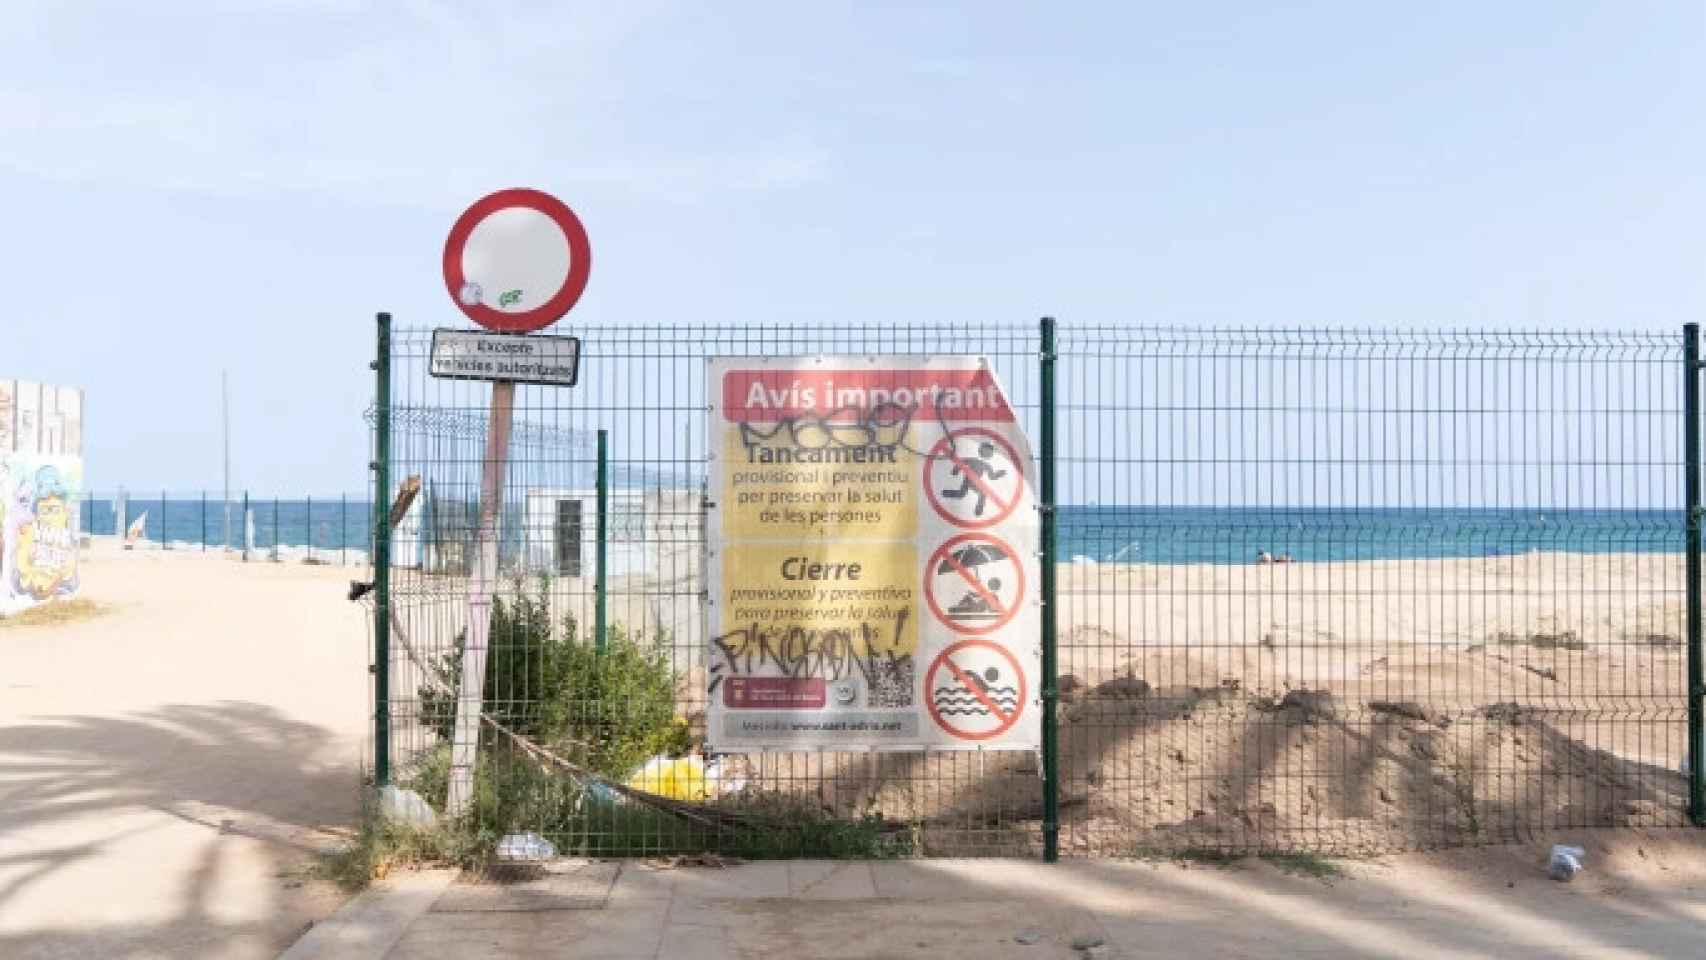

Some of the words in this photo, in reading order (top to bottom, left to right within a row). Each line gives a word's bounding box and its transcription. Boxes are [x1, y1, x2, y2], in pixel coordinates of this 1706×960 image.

[745, 375, 817, 409] Avís
[824, 379, 1002, 417] important
[747, 443, 897, 464] Tancament
[731, 470, 818, 488] provisional
[832, 470, 909, 488] preventiu
[737, 492, 766, 508] per
[771, 492, 843, 508] preservar
[847, 489, 861, 504] la
[864, 489, 903, 504] salut
[759, 509, 781, 524] de
[785, 509, 806, 524] les
[810, 510, 882, 527] persones
[781, 556, 862, 581] Cierre
[730, 586, 815, 604] provisional
[817, 590, 828, 604] y
[735, 608, 770, 621] para
[773, 607, 845, 622] preservar
[850, 605, 864, 619] la
